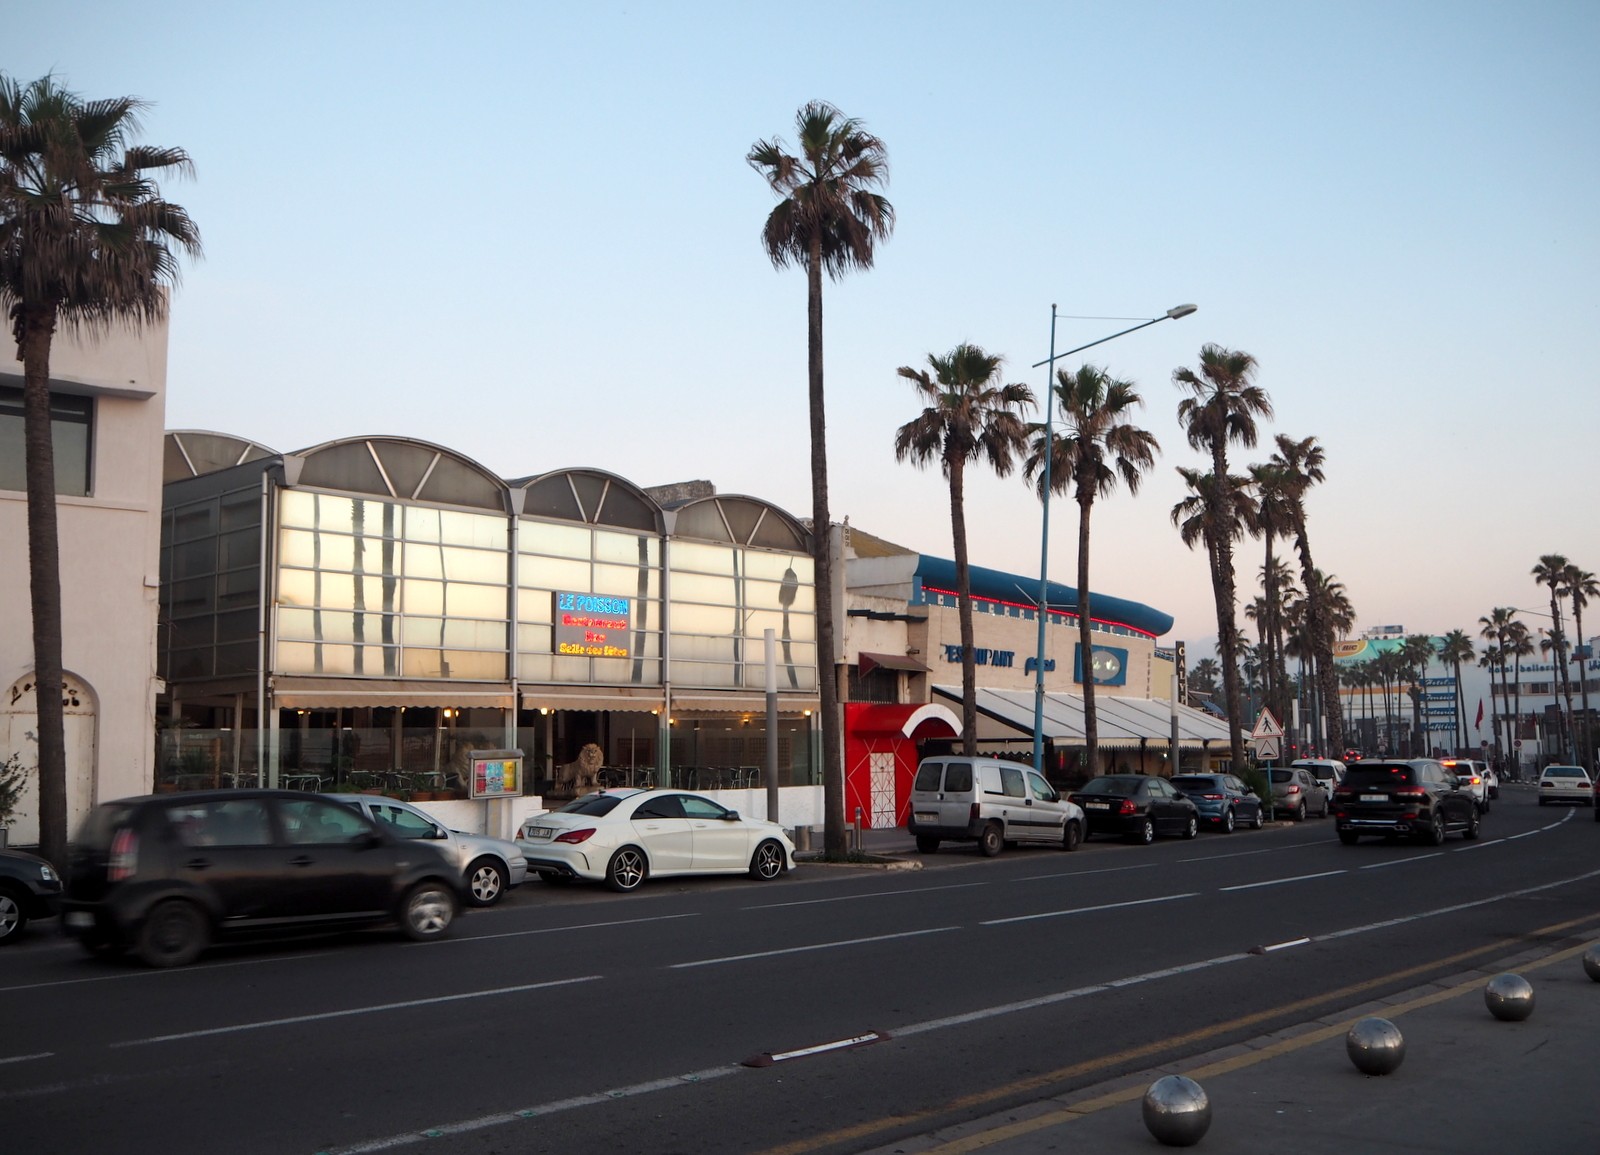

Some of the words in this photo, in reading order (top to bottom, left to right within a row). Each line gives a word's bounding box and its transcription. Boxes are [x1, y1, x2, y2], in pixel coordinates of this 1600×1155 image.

[559, 594, 574, 610] LE
[577, 595, 628, 615] POISSON
[939, 644, 1015, 667] RESURANT
